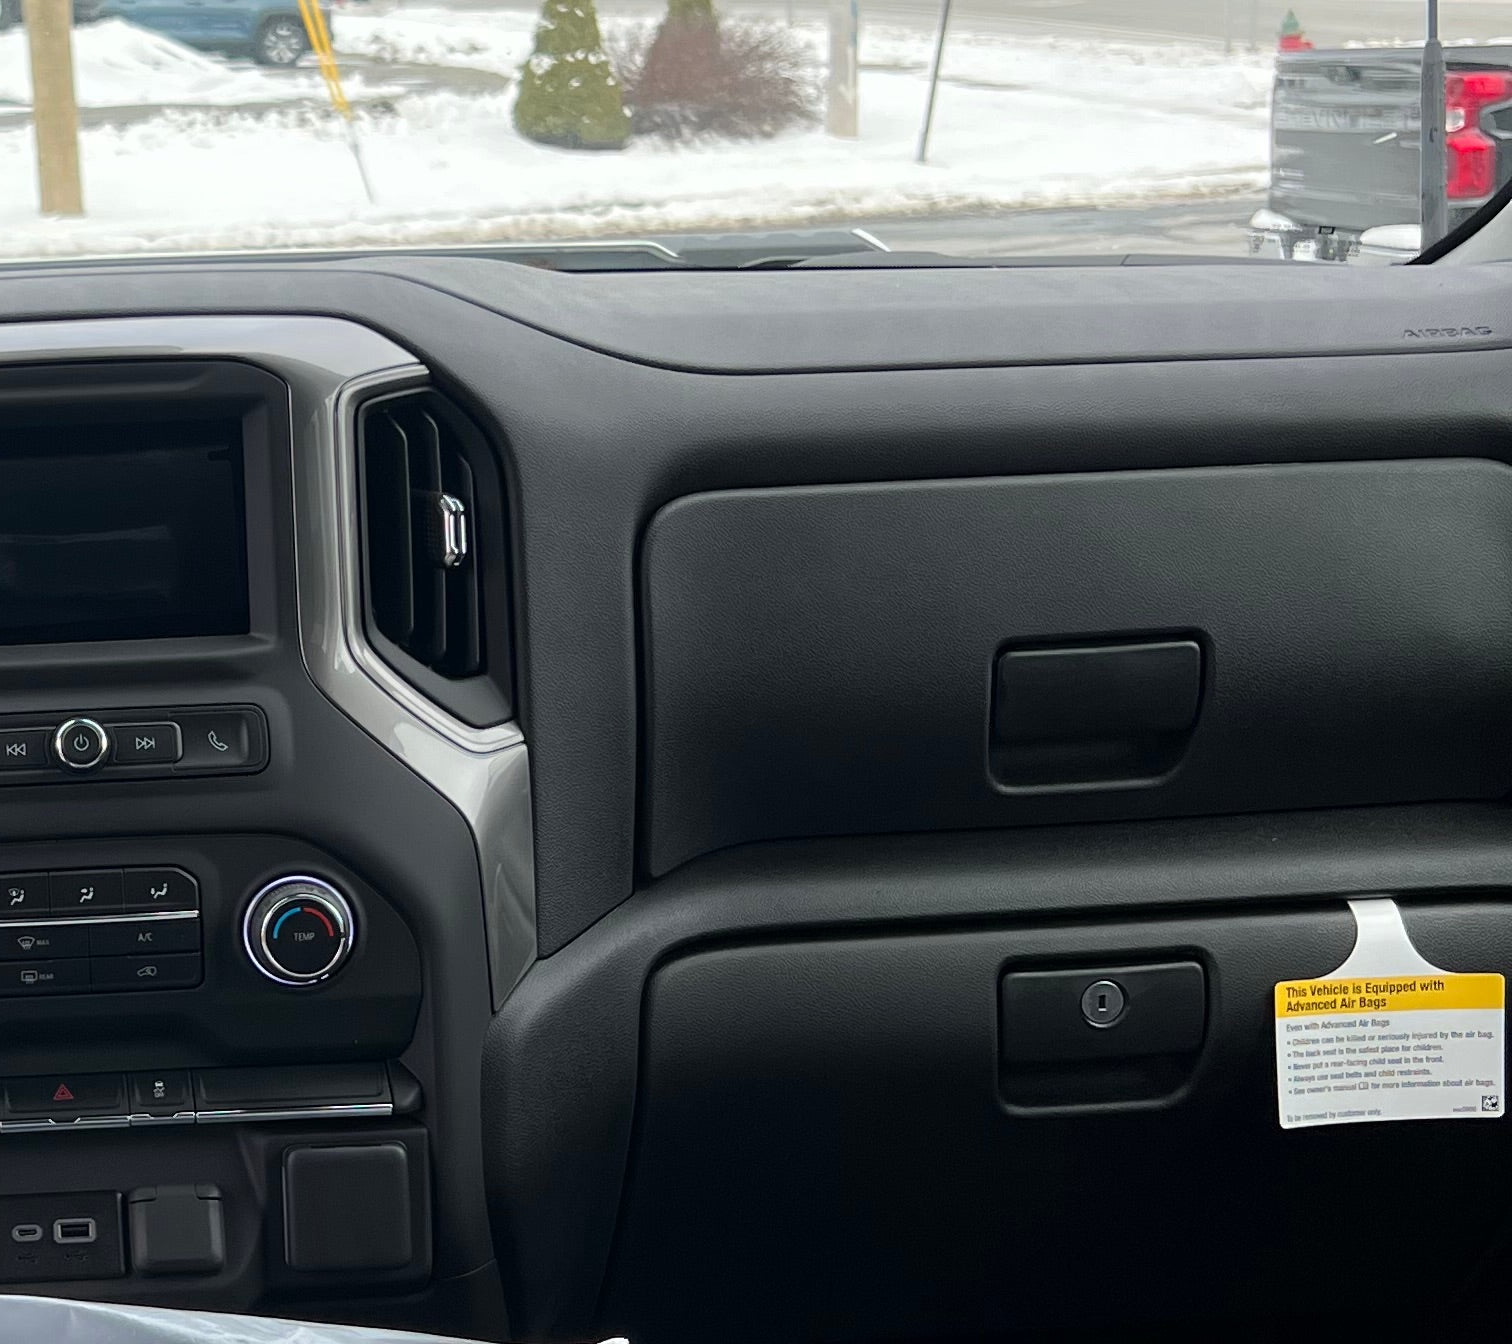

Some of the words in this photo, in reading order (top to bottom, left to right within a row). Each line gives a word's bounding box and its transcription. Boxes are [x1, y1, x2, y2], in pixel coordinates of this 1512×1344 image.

[1403, 326, 1492, 338] AIRBAG
[138, 932, 153, 942] A/C
[293, 932, 315, 942] TEMP
[1286, 986, 1307, 998] This
[1310, 984, 1349, 996] Vehicle
[1352, 983, 1362, 994] is
[1365, 981, 1416, 995] Equipped
[1420, 980, 1445, 992] with
[1286, 999, 1337, 1012] Advanced
[1340, 998, 1356, 1009] Air
[1359, 997, 1387, 1010] Bags
[1321, 1020, 1357, 1029] Advanced
[1358, 1019, 1369, 1028] Air
